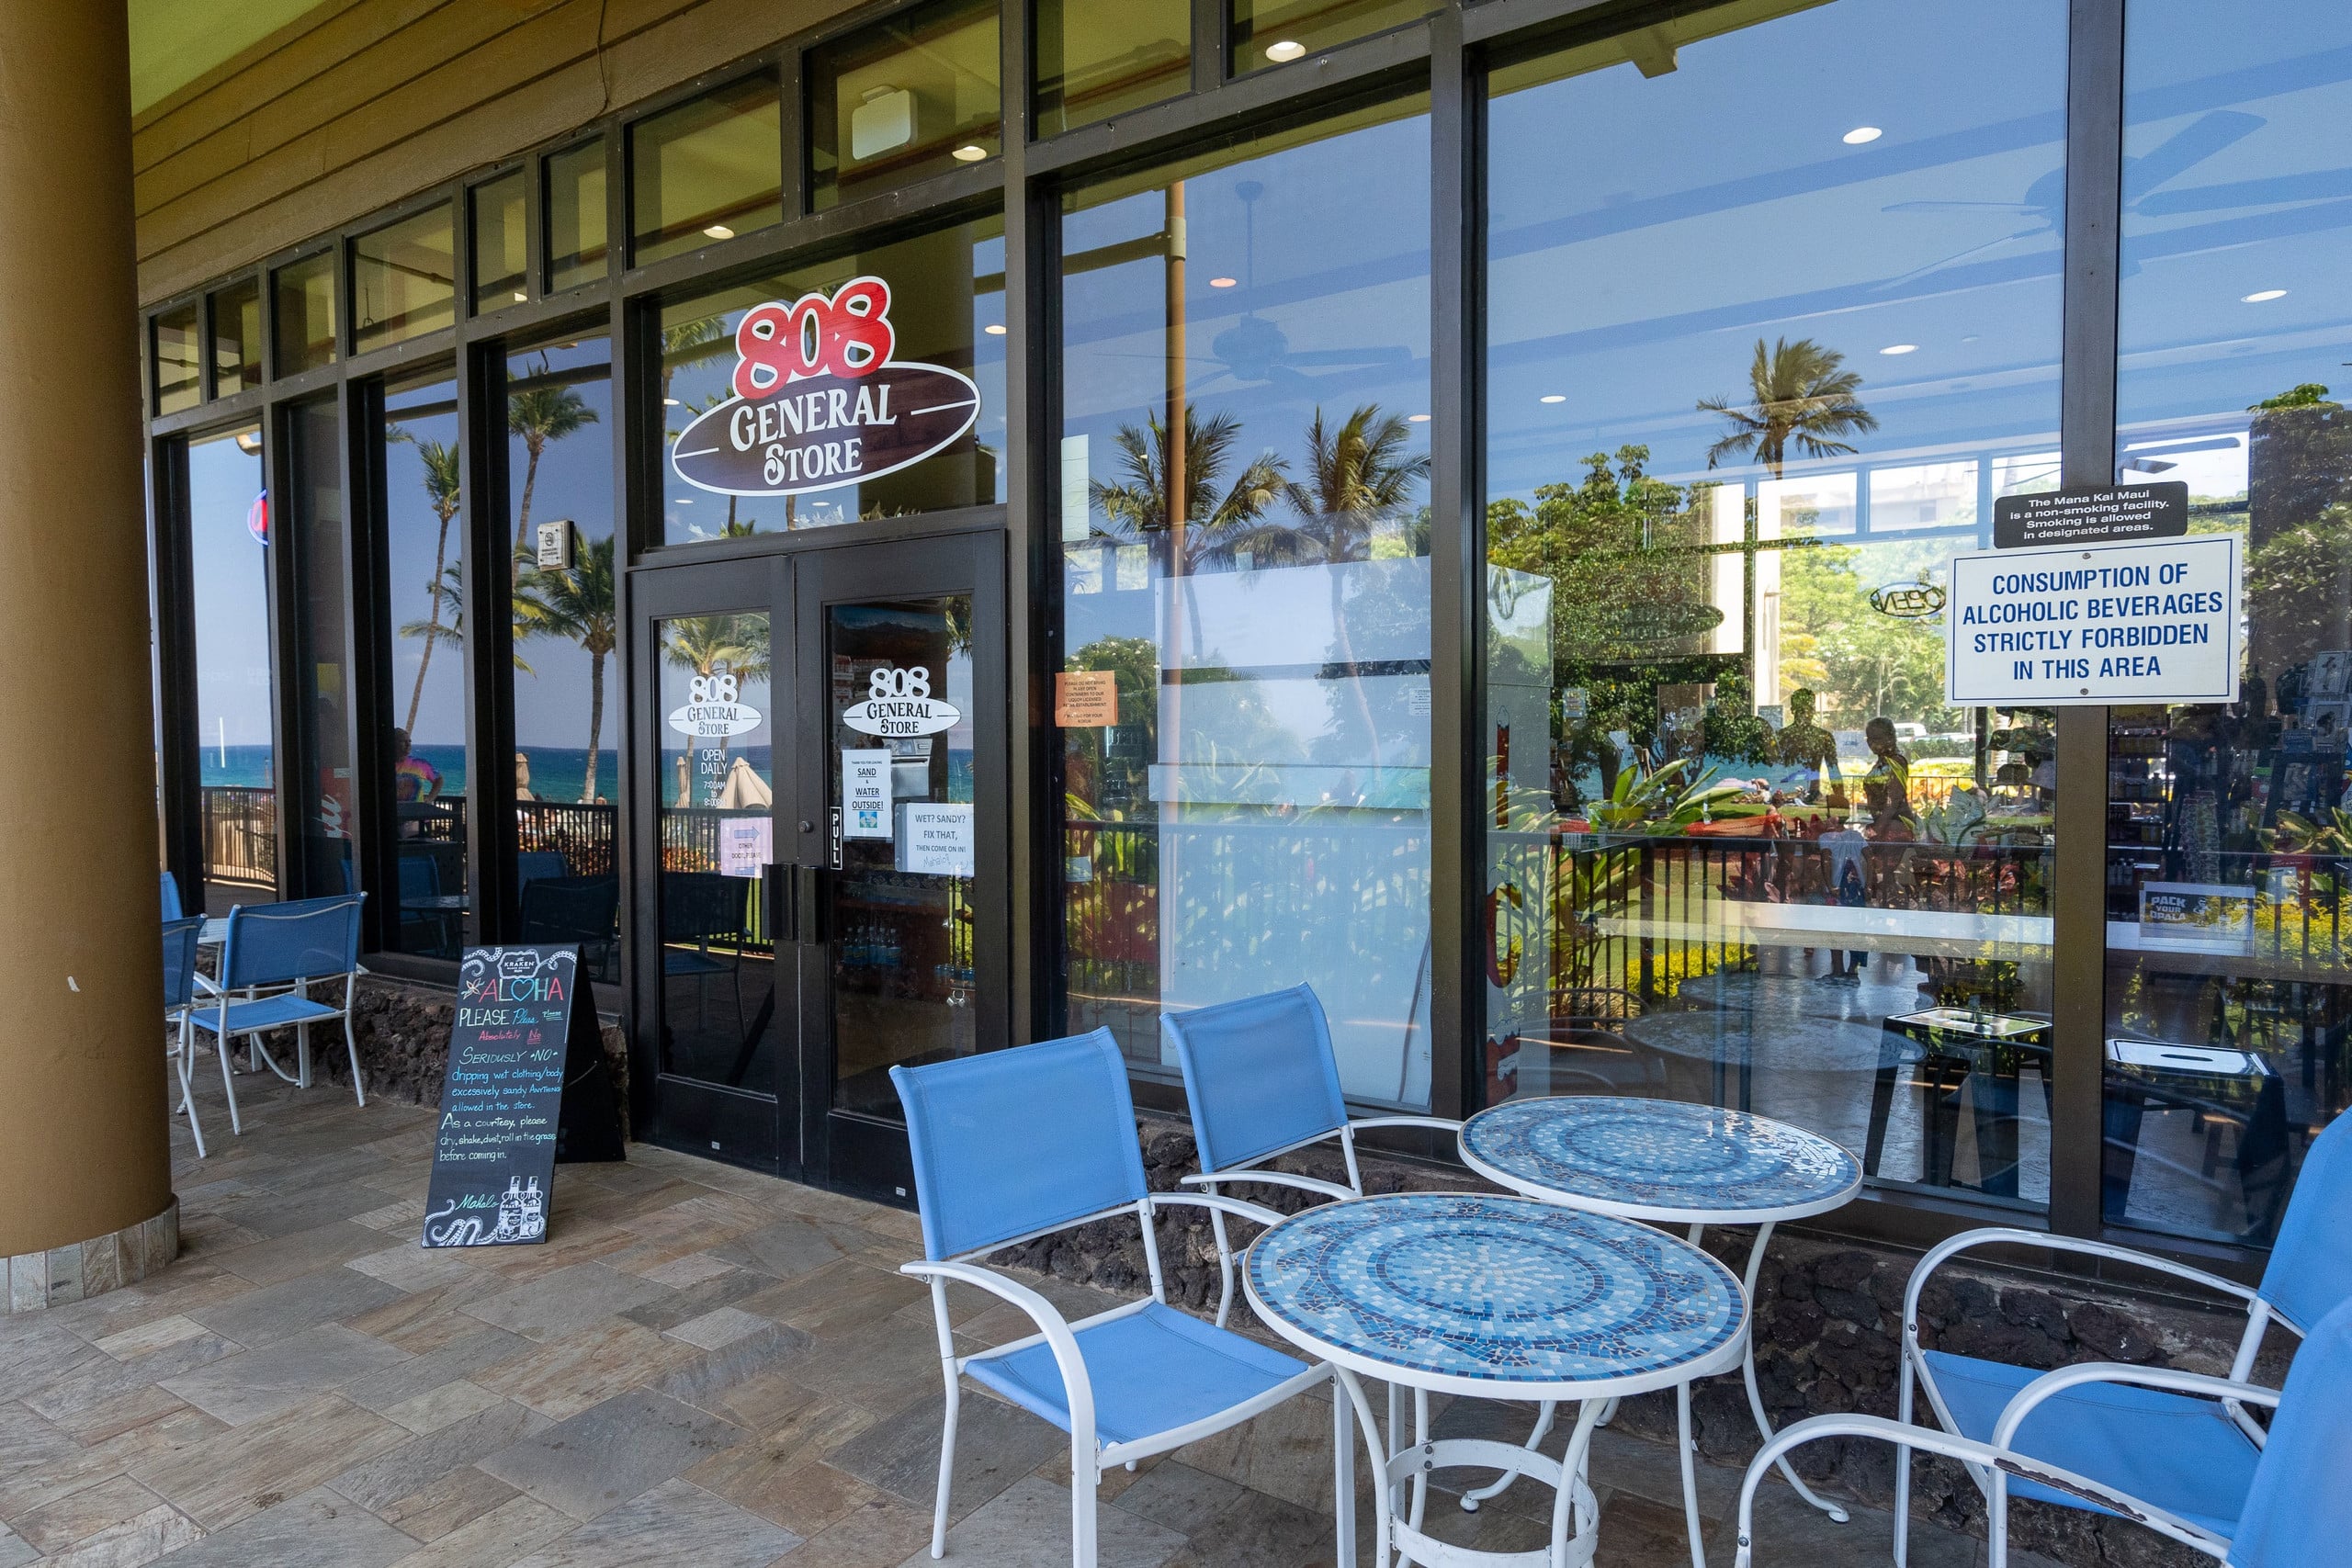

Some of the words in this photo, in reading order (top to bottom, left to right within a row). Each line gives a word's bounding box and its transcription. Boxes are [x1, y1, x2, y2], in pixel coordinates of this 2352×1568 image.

[732, 276, 896, 400] 808
[729, 384, 899, 452] GENERAL
[763, 437, 864, 486] STORE
[2029, 498, 2051, 508] The
[2054, 495, 2090, 505] Mana
[2093, 492, 2114, 502] Kai
[2117, 490, 2150, 500] Maui
[2009, 511, 2021, 520] is
[2024, 511, 2032, 519] a
[2035, 502, 2120, 518] non-smoking
[2122, 499, 2170, 511] facility.
[2026, 515, 2082, 529] Smoking
[2086, 514, 2098, 524] is
[2100, 512, 2152, 523] allowed
[2023, 531, 2035, 540] in
[2038, 525, 2109, 540] designated
[2112, 524, 2154, 533] areas.
[1993, 565, 2150, 595] CONSUMPTION
[2159, 562, 2188, 585] OF
[1962, 600, 2079, 625] ALCOHOLIC
[2087, 591, 2223, 620] BEVERAGES
[1973, 630, 2073, 653] STRICTLY
[2082, 623, 2209, 649] FORBIDDEN
[2013, 660, 2033, 680] IN
[2041, 659, 2089, 679] THIS
[2099, 656, 2162, 678] AREA
[689, 673, 739, 705] 808
[869, 666, 932, 701] 808
[687, 706, 739, 723] GENERAL
[866, 702, 933, 719] GENERAL
[698, 721, 729, 735] STORE
[879, 718, 920, 734] STORE
[702, 749, 725, 761] OPEN
[700, 762, 728, 774] DAILY
[857, 767, 876, 776] SAND
[855, 787, 880, 796] WATER
[852, 800, 884, 809] OUTSIDE!
[914, 814, 935, 823] WET?
[936, 814, 967, 824] SANDY?
[923, 829, 935, 839] FIX
[935, 830, 958, 840] THAT,
[2151, 896, 2187, 908] PACK
[458, 1007, 511, 1027] PLEASE
[478, 1029, 522, 1041] Absolutely
[451, 1066, 490, 1084] dripping
[493, 1069, 510, 1079] wet
[451, 1084, 500, 1100] excessively
[503, 1085, 527, 1098] sandy
[451, 1100, 484, 1112] allowed
[496, 1101, 510, 1111] the
[514, 1100, 536, 1111] store.
[441, 1112, 461, 1130] As
[463, 1120, 472, 1128] a
[520, 1114, 548, 1129] please
[501, 1132, 514, 1143] roll
[523, 1132, 536, 1142] the
[535, 1133, 558, 1145] grass
[439, 1148, 467, 1162] before
[469, 1151, 496, 1163] coming
[455, 1193, 500, 1211] Mahalo
